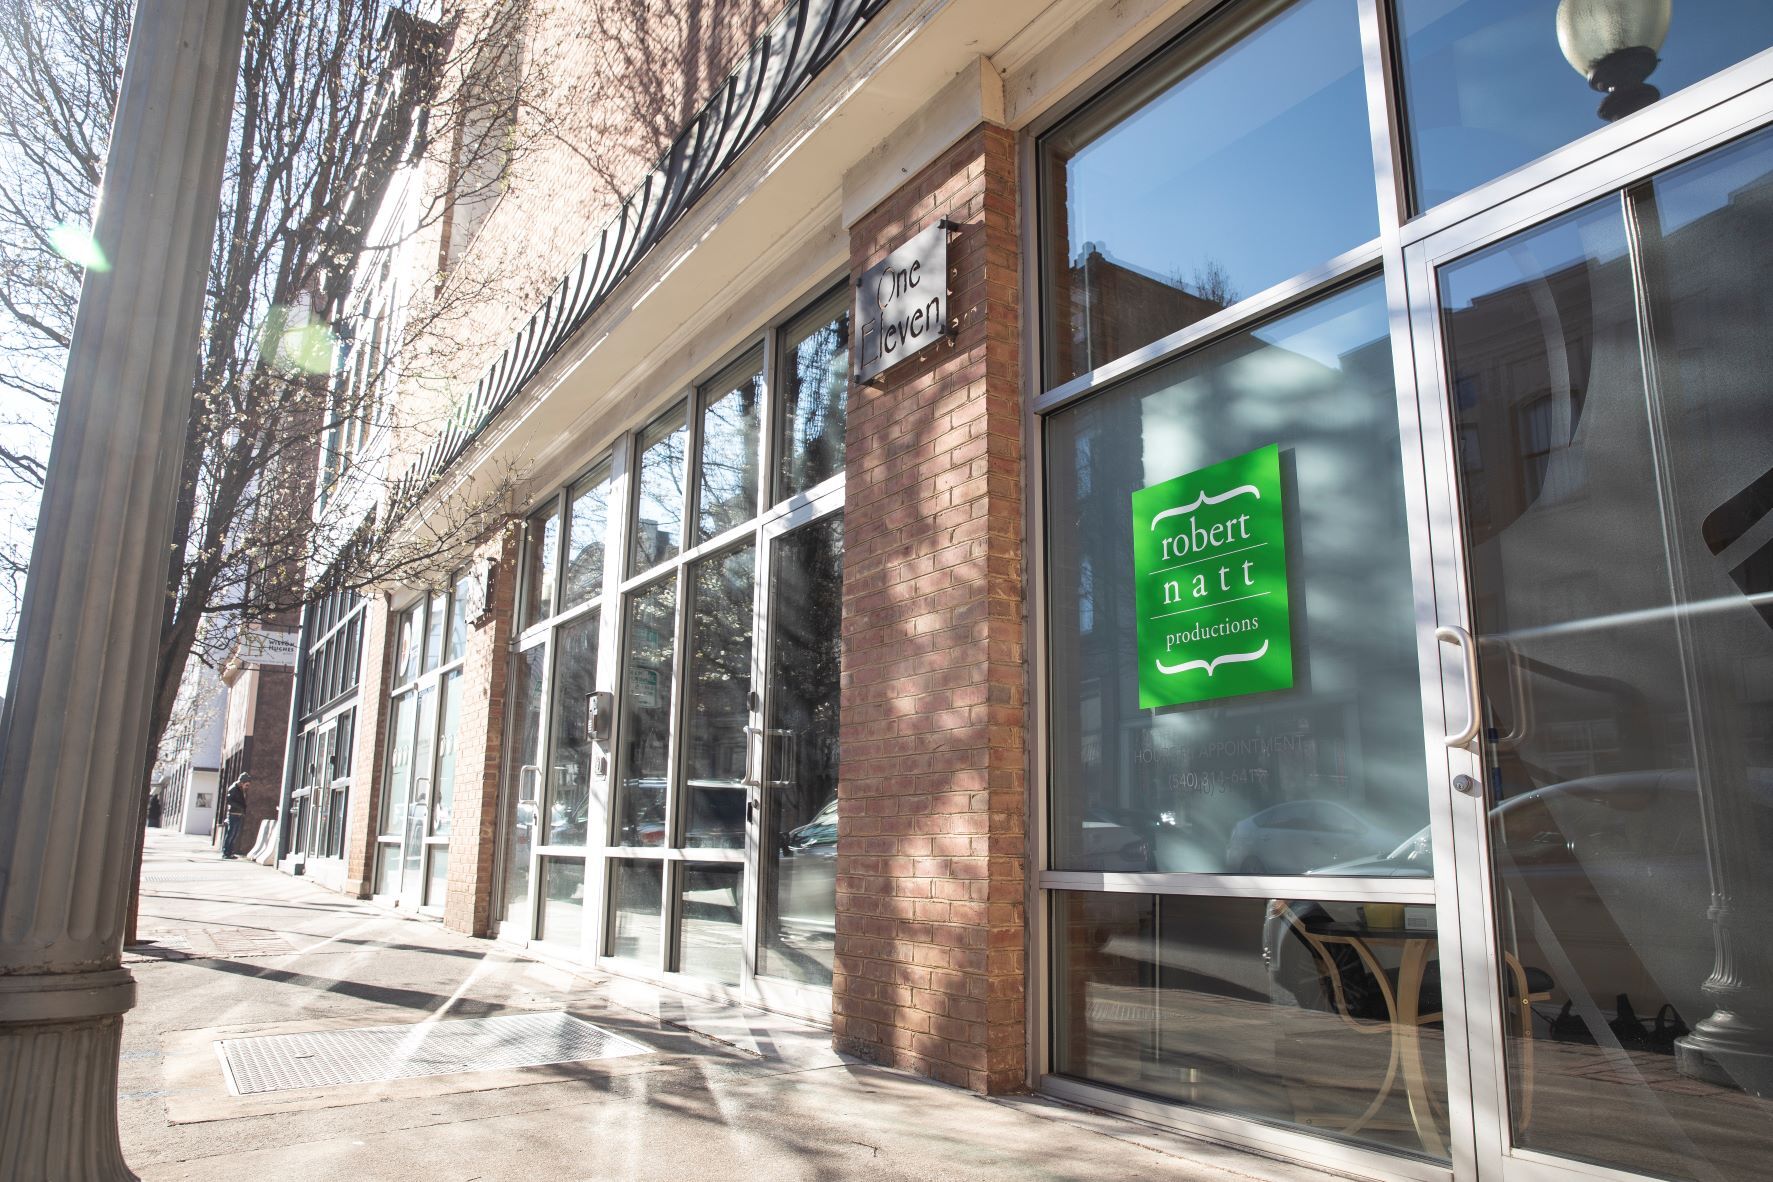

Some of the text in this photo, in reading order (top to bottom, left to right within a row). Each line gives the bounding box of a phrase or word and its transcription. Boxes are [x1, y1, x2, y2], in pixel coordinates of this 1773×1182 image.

[877, 259, 921, 310] One
[860, 296, 940, 370] Eleven
[1161, 512, 1251, 560] robert
[1163, 559, 1255, 604] natt
[1166, 615, 1260, 651] productions
[1200, 735, 1305, 758] APPOINTMENT
[1169, 771, 1198, 790] (540)
